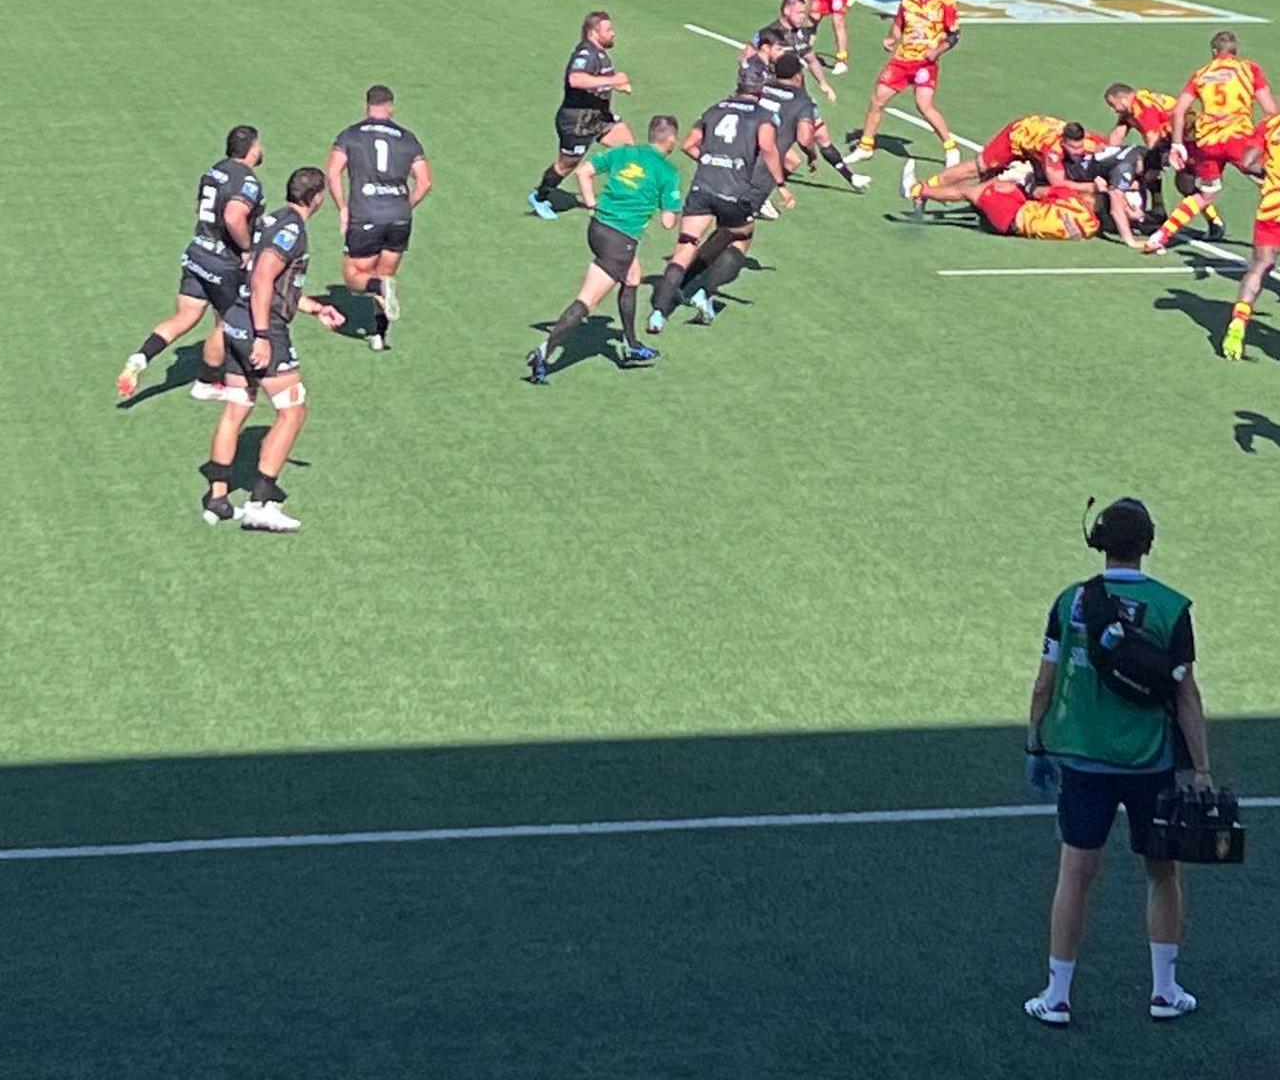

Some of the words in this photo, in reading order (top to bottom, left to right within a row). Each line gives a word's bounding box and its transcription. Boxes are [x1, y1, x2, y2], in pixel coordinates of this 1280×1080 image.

[1213, 83, 1228, 108] 5
[713, 113, 740, 145] 4
[373, 138, 389, 173] 1
[199, 184, 218, 223] 2
